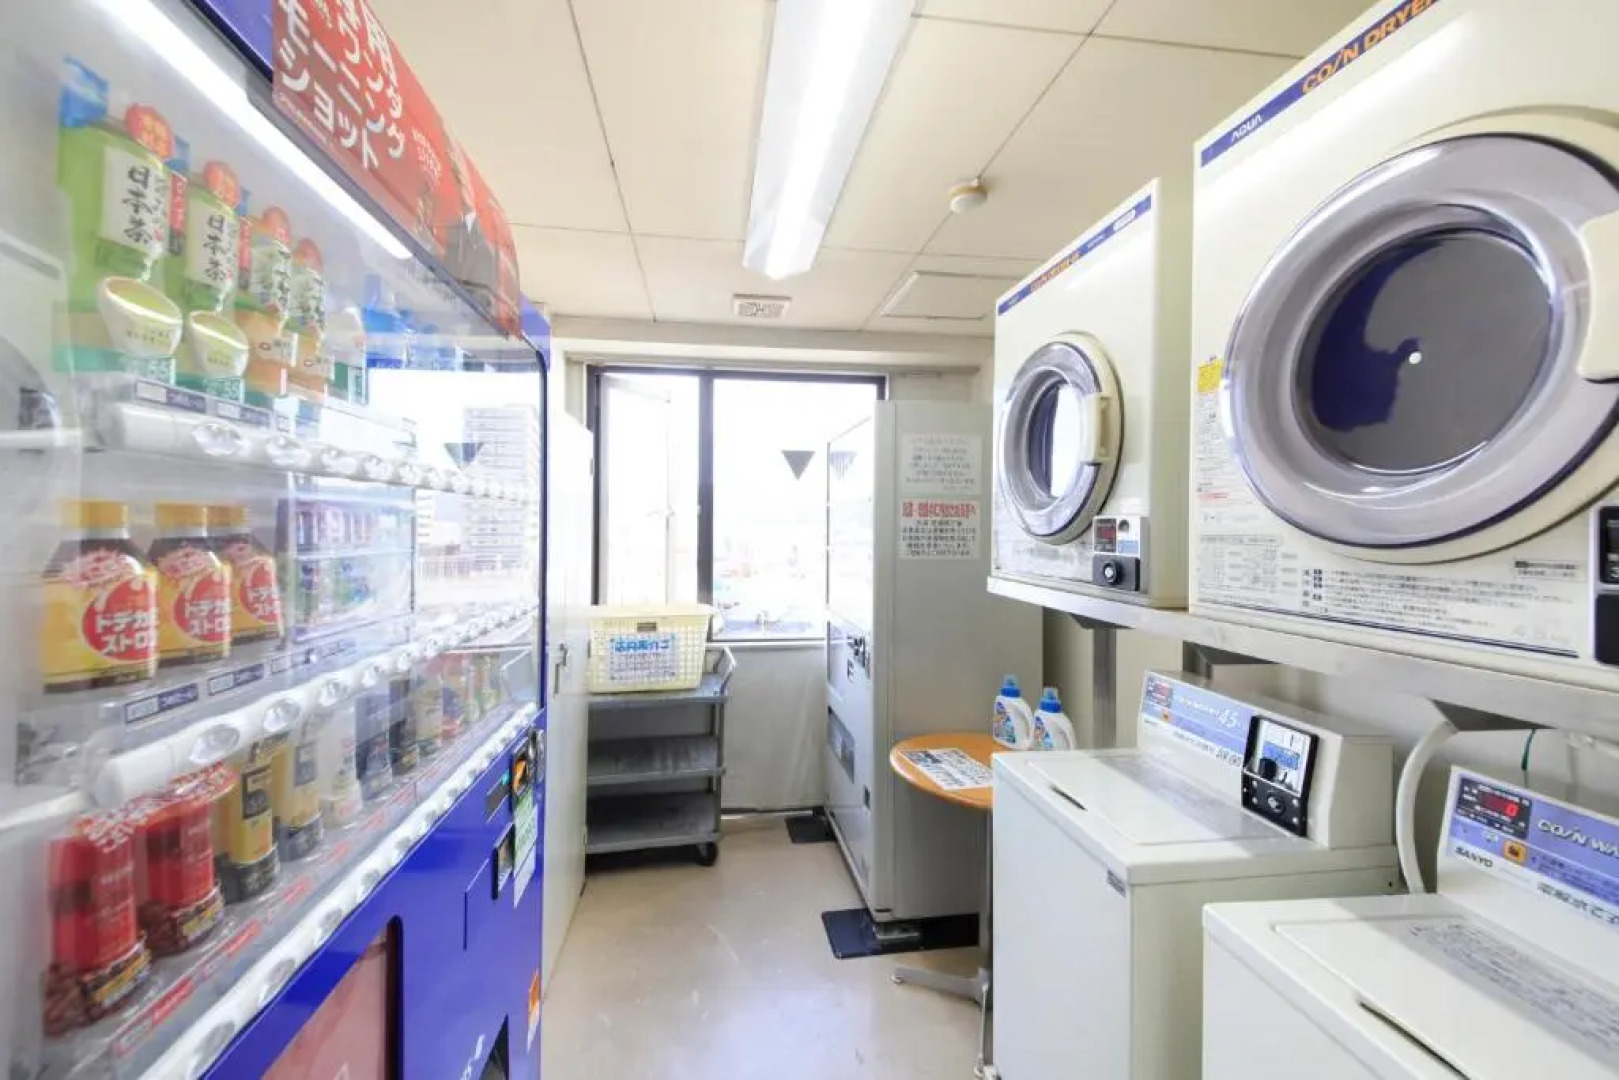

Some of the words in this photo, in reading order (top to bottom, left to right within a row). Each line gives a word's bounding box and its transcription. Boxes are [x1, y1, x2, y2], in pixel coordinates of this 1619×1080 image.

[278, 37, 379, 169] ショット
[1230, 113, 1263, 143] AQUA
[1455, 845, 1494, 868] SANYO
